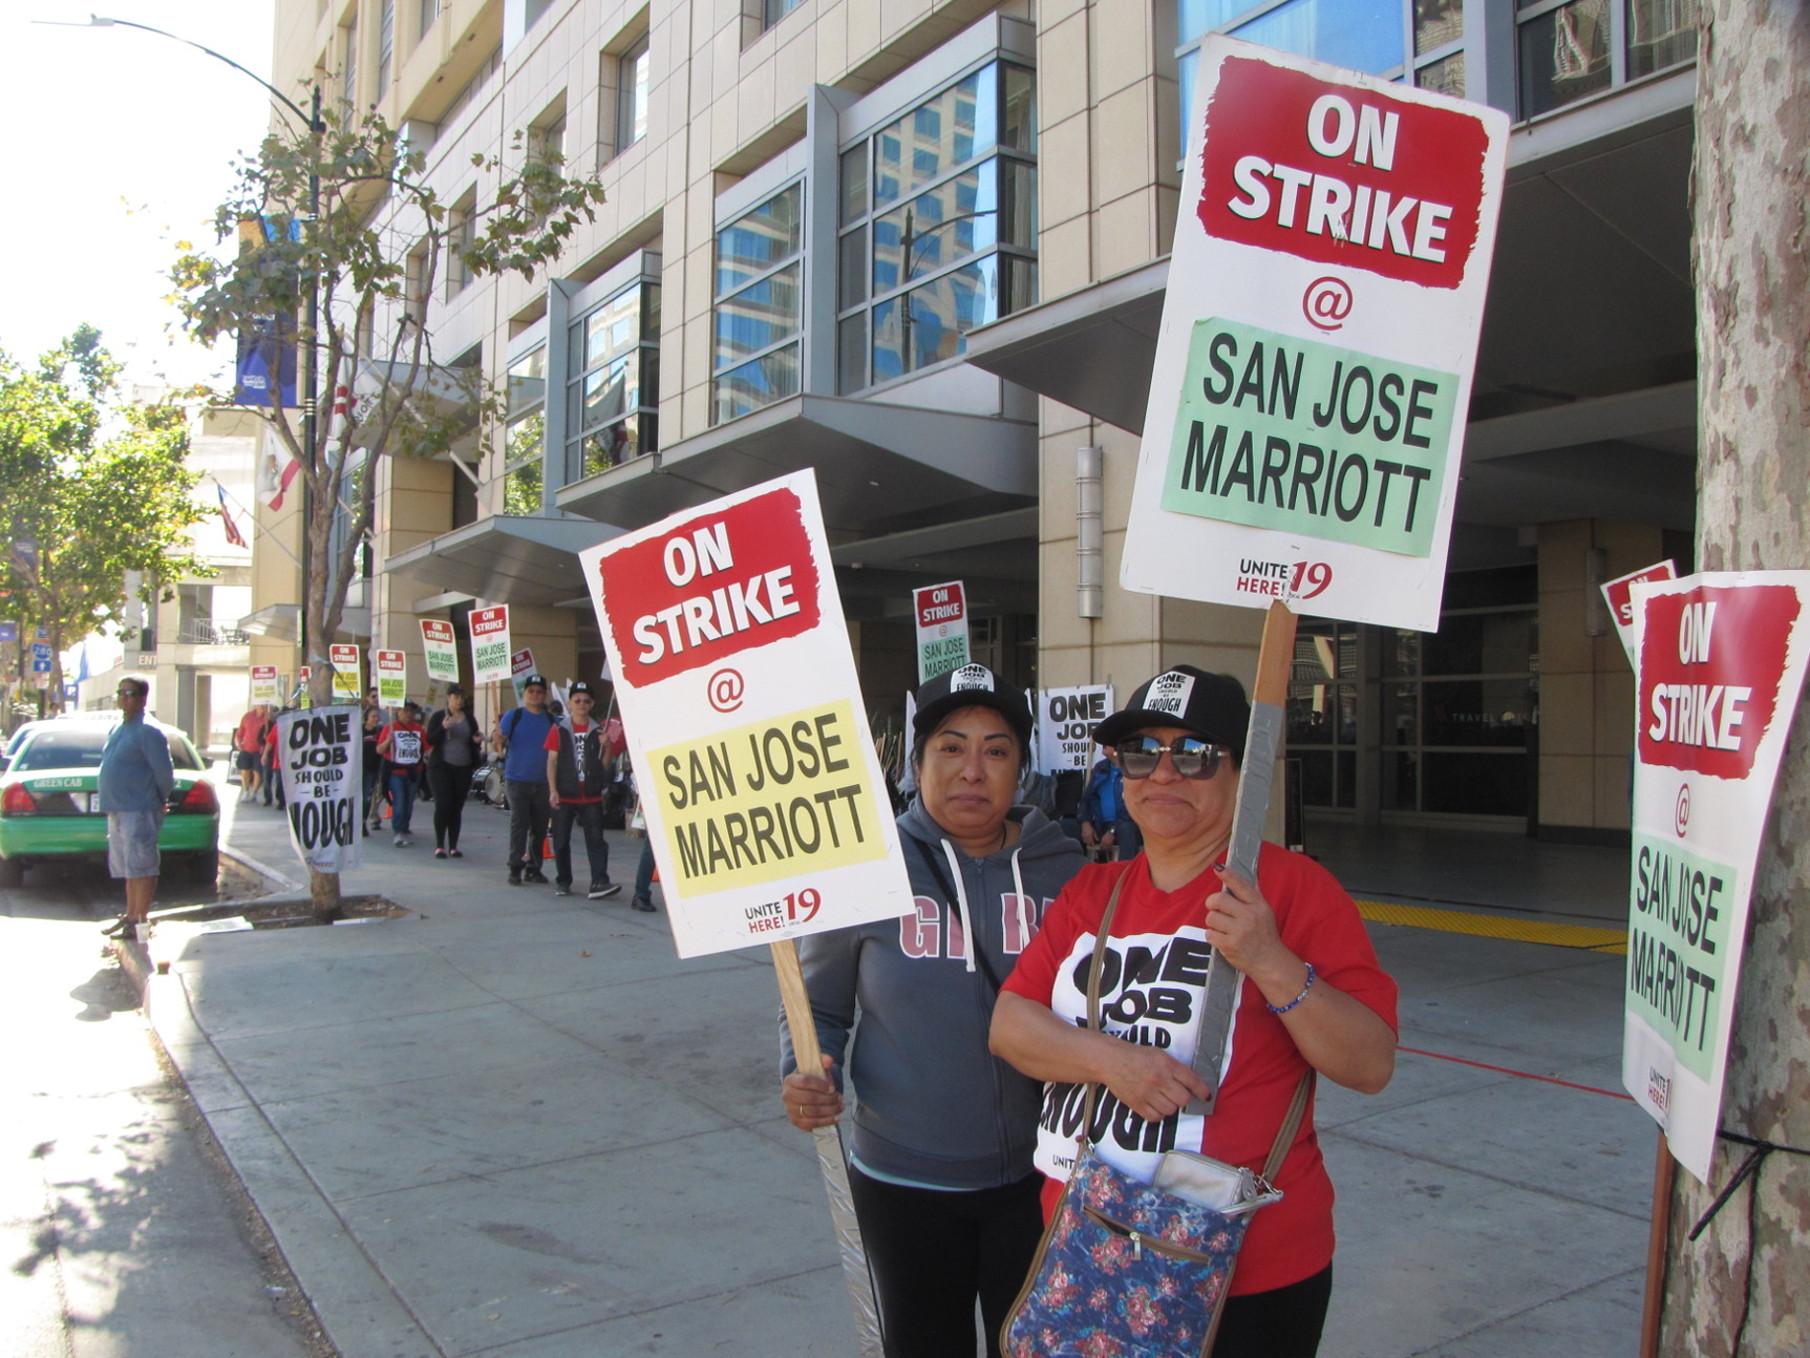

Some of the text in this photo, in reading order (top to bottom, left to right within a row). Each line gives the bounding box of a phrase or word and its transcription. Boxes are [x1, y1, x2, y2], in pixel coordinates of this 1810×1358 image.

[1306, 94, 1399, 172] ON
[1227, 155, 1454, 264] STRIKE
[1302, 276, 1353, 330] @
[1203, 332, 1438, 449] SAN JOSE
[1181, 420, 1431, 533] MARRIOTT
[663, 522, 734, 588] ON
[1239, 558, 1288, 579] UNITE
[1236, 576, 1285, 597] HERE!
[1292, 561, 1333, 600] 19
[932, 589, 949, 604] ON
[482, 611, 494, 621] ON
[633, 565, 800, 665] STRIKE
[923, 602, 960, 622] STRIKE
[427, 630, 451, 640] STRIKE
[432, 622, 442, 631] ON
[475, 619, 504, 633] STRIKE
[1679, 602, 1717, 666] ON
[476, 643, 505, 658] SAN JOSE
[924, 638, 964, 660] SAN JOSE
[924, 655, 966, 677] MARRIOTT
[957, 665, 987, 674] ONE
[1157, 673, 1187, 684] ONE
[707, 668, 745, 714] @
[1049, 693, 1107, 722] ONE
[1148, 698, 1182, 712] ENOUGH
[1648, 683, 1753, 751] STRIKE
[289, 713, 351, 750] ONE
[291, 746, 348, 770] JOB
[663, 741, 737, 810] SAN
[746, 713, 850, 791] JOSE
[1074, 755, 1087, 767] BE
[34, 778, 82, 788] GREEN CAB
[295, 769, 344, 784] SHOULD
[313, 785, 331, 799] BE
[1675, 783, 1691, 838] @
[674, 784, 865, 880] MARRIOTT
[745, 901, 783, 920] UNITE
[783, 887, 822, 923] 19
[1636, 846, 1724, 956] SAN JOSE
[748, 915, 785, 933] HERE!
[1073, 937, 1212, 998] ONE
